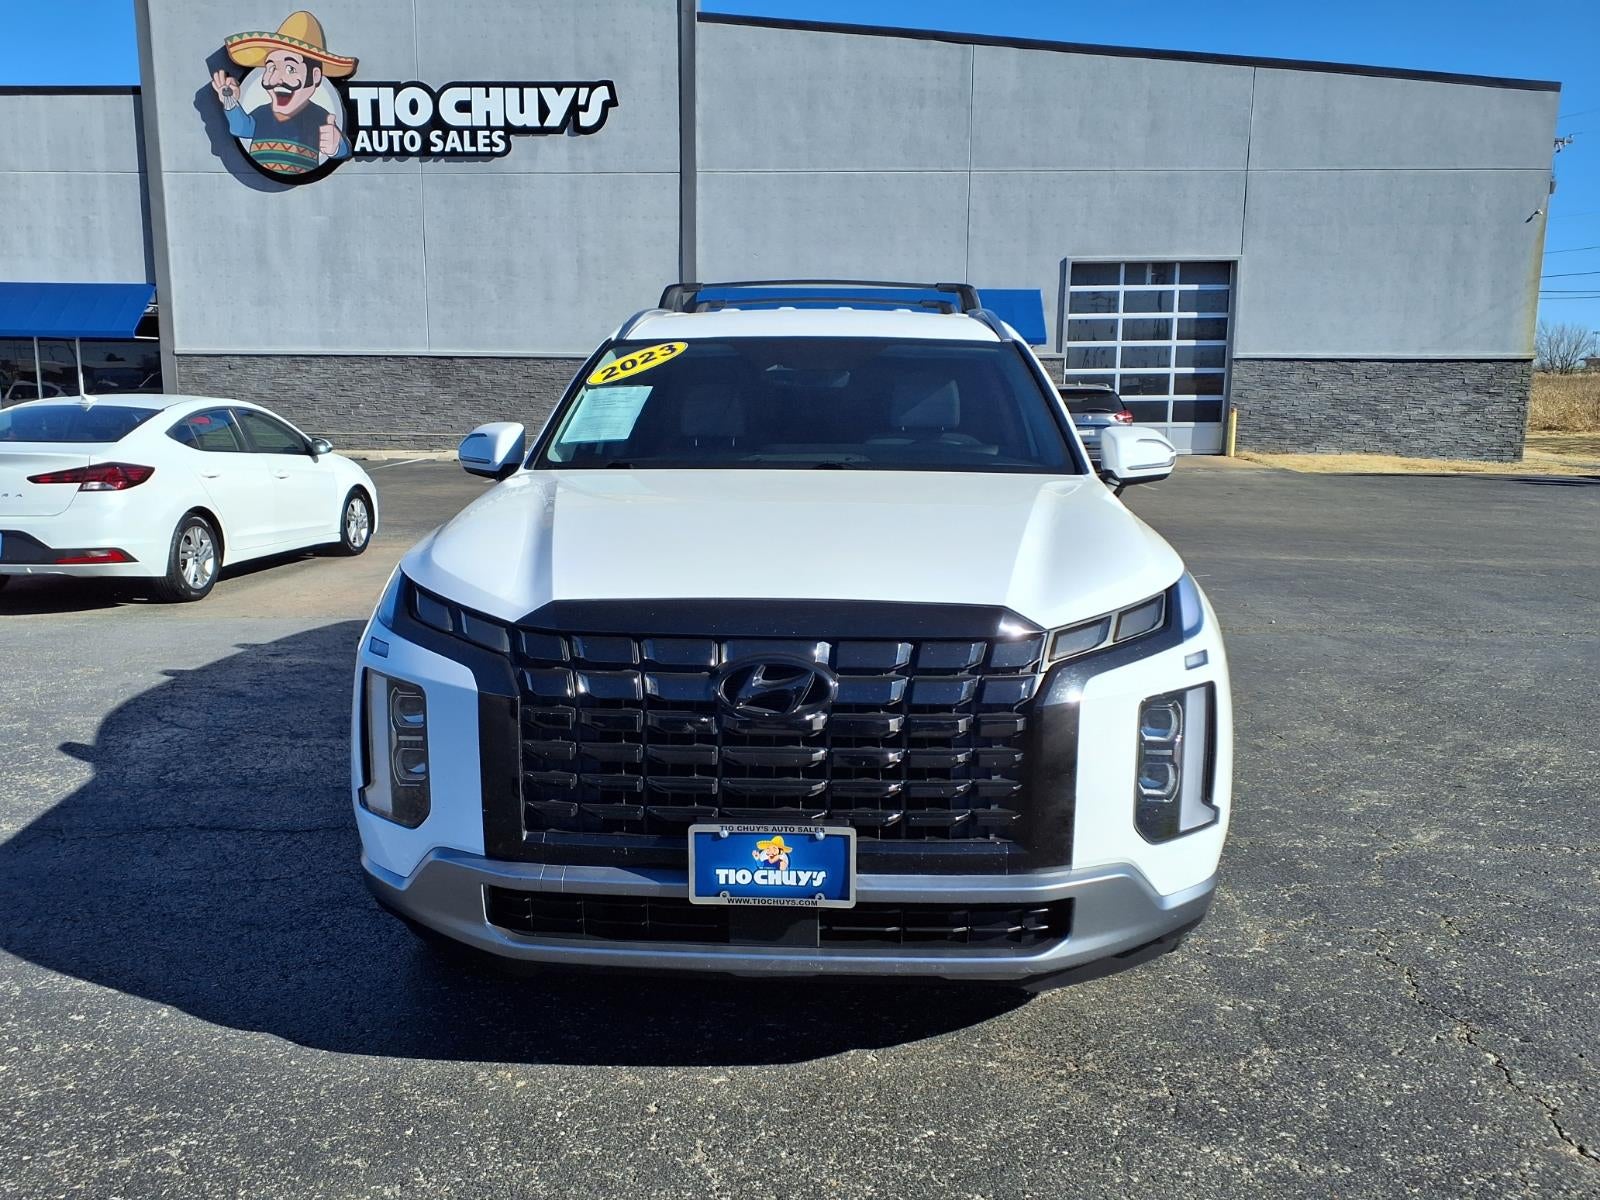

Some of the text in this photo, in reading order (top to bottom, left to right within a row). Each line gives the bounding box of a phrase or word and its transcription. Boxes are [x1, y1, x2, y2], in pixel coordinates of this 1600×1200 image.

[349, 86, 611, 127] TIO CHUY'S
[354, 130, 506, 153] AUTO SALES
[600, 344, 678, 381] 2023
[737, 825, 769, 833] CHUY'S
[797, 826, 826, 834] SALES
[716, 869, 826, 887] TIO CHUY'S
[727, 897, 818, 907] WWW.TIOCHUYS.COM
